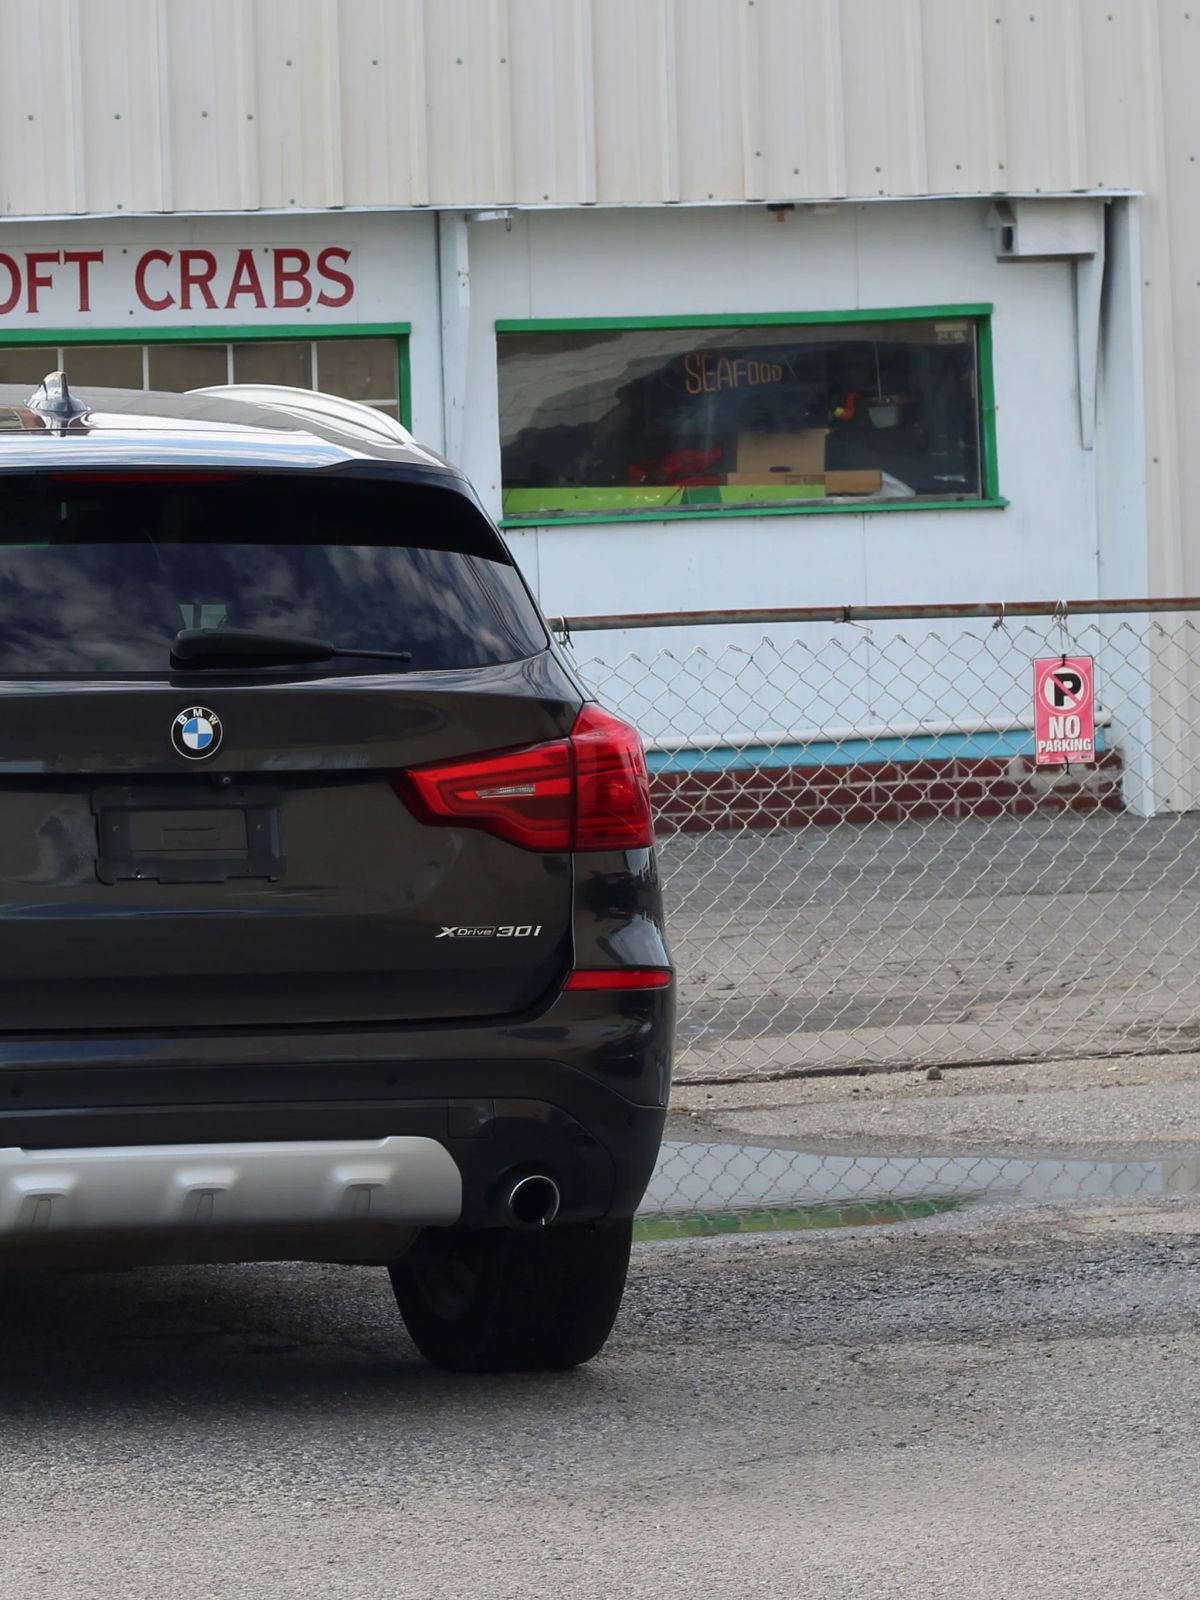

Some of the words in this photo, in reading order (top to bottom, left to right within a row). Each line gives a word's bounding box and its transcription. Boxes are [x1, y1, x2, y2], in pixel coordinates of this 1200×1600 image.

[134, 247, 356, 311] CRABS
[684, 352, 784, 395] SEAFOOD
[177, 708, 220, 726] BMW
[1048, 715, 1081, 739] NO
[1038, 738, 1092, 753] PARKING
